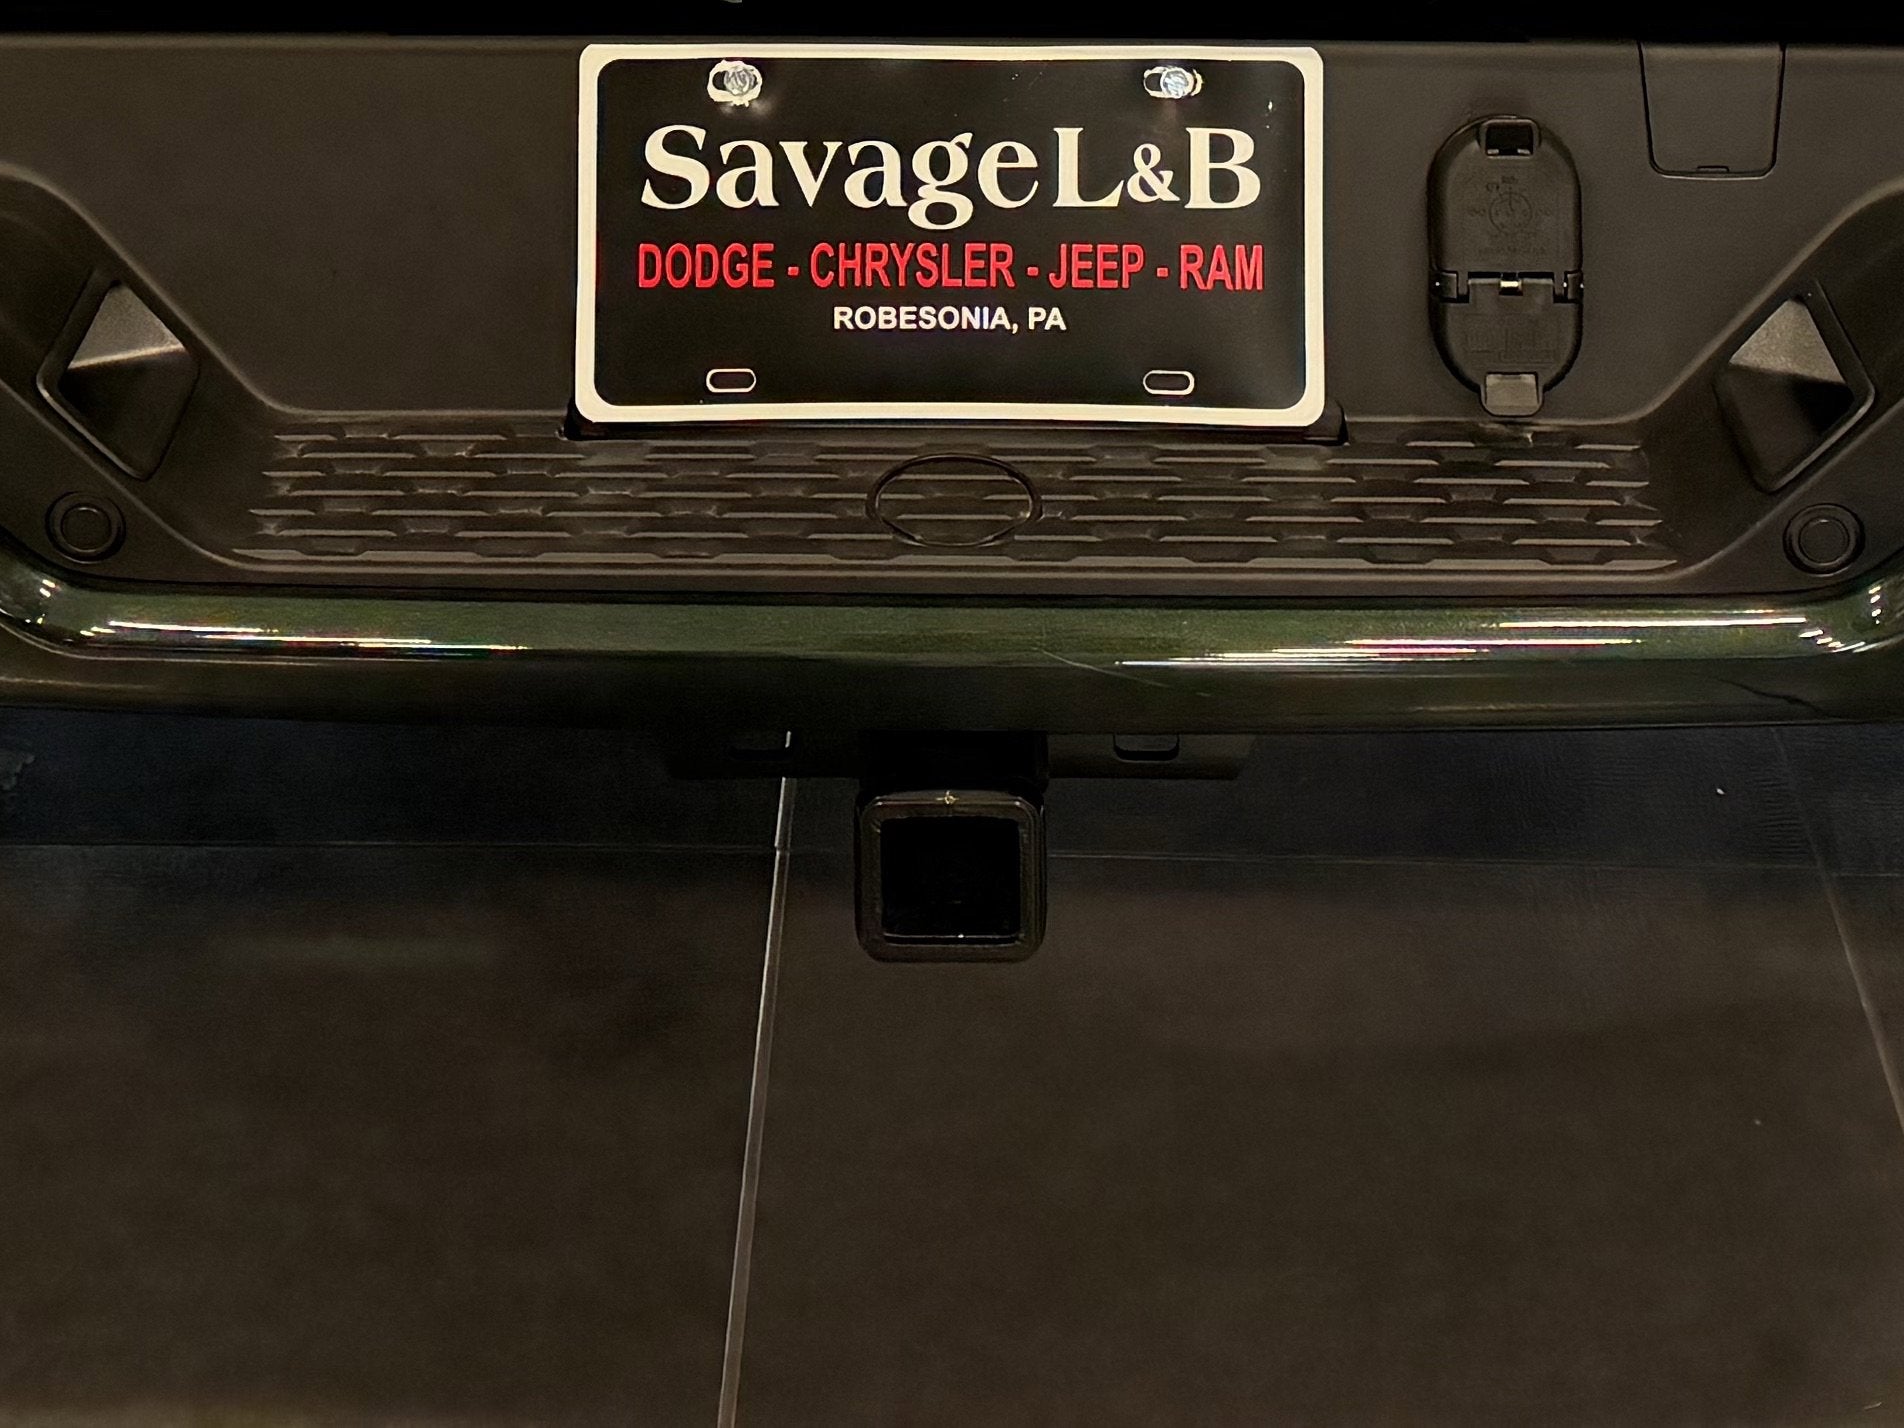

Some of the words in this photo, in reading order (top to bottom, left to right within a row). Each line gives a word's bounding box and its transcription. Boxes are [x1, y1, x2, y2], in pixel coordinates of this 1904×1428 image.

[641, 124, 1039, 229] Savage
[1053, 126, 1261, 209] L&B
[637, 242, 776, 289] DODGE
[809, 242, 1016, 289] CHRYSLER
[1048, 242, 1146, 290] JEEP
[1179, 243, 1265, 292] RAM
[833, 305, 1019, 335] ROBESONIA,
[1028, 306, 1067, 332] PA
